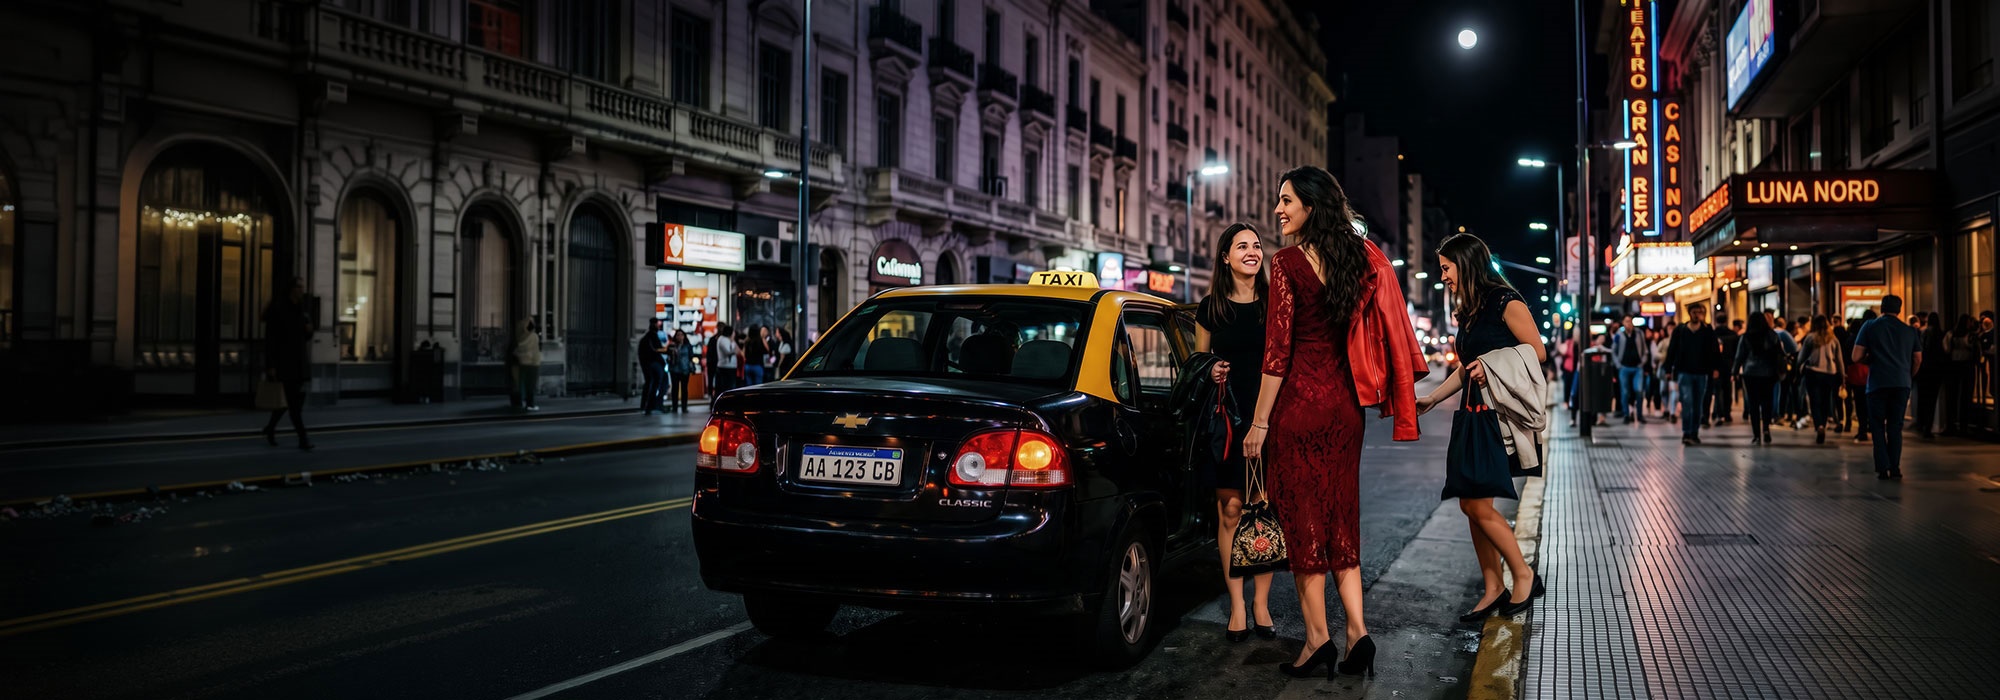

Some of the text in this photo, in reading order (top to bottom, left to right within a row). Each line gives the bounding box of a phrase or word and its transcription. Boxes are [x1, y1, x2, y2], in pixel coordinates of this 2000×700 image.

[1630, 99, 1648, 165] GRAN
[1664, 102, 1682, 228] CASINO
[1632, 176, 1648, 228] REX
[1746, 179, 1880, 204] LUNA NORD
[1039, 273, 1084, 286] TAXI
[804, 457, 895, 481] AA 123 CB
[938, 498, 993, 508] CLASSIC
